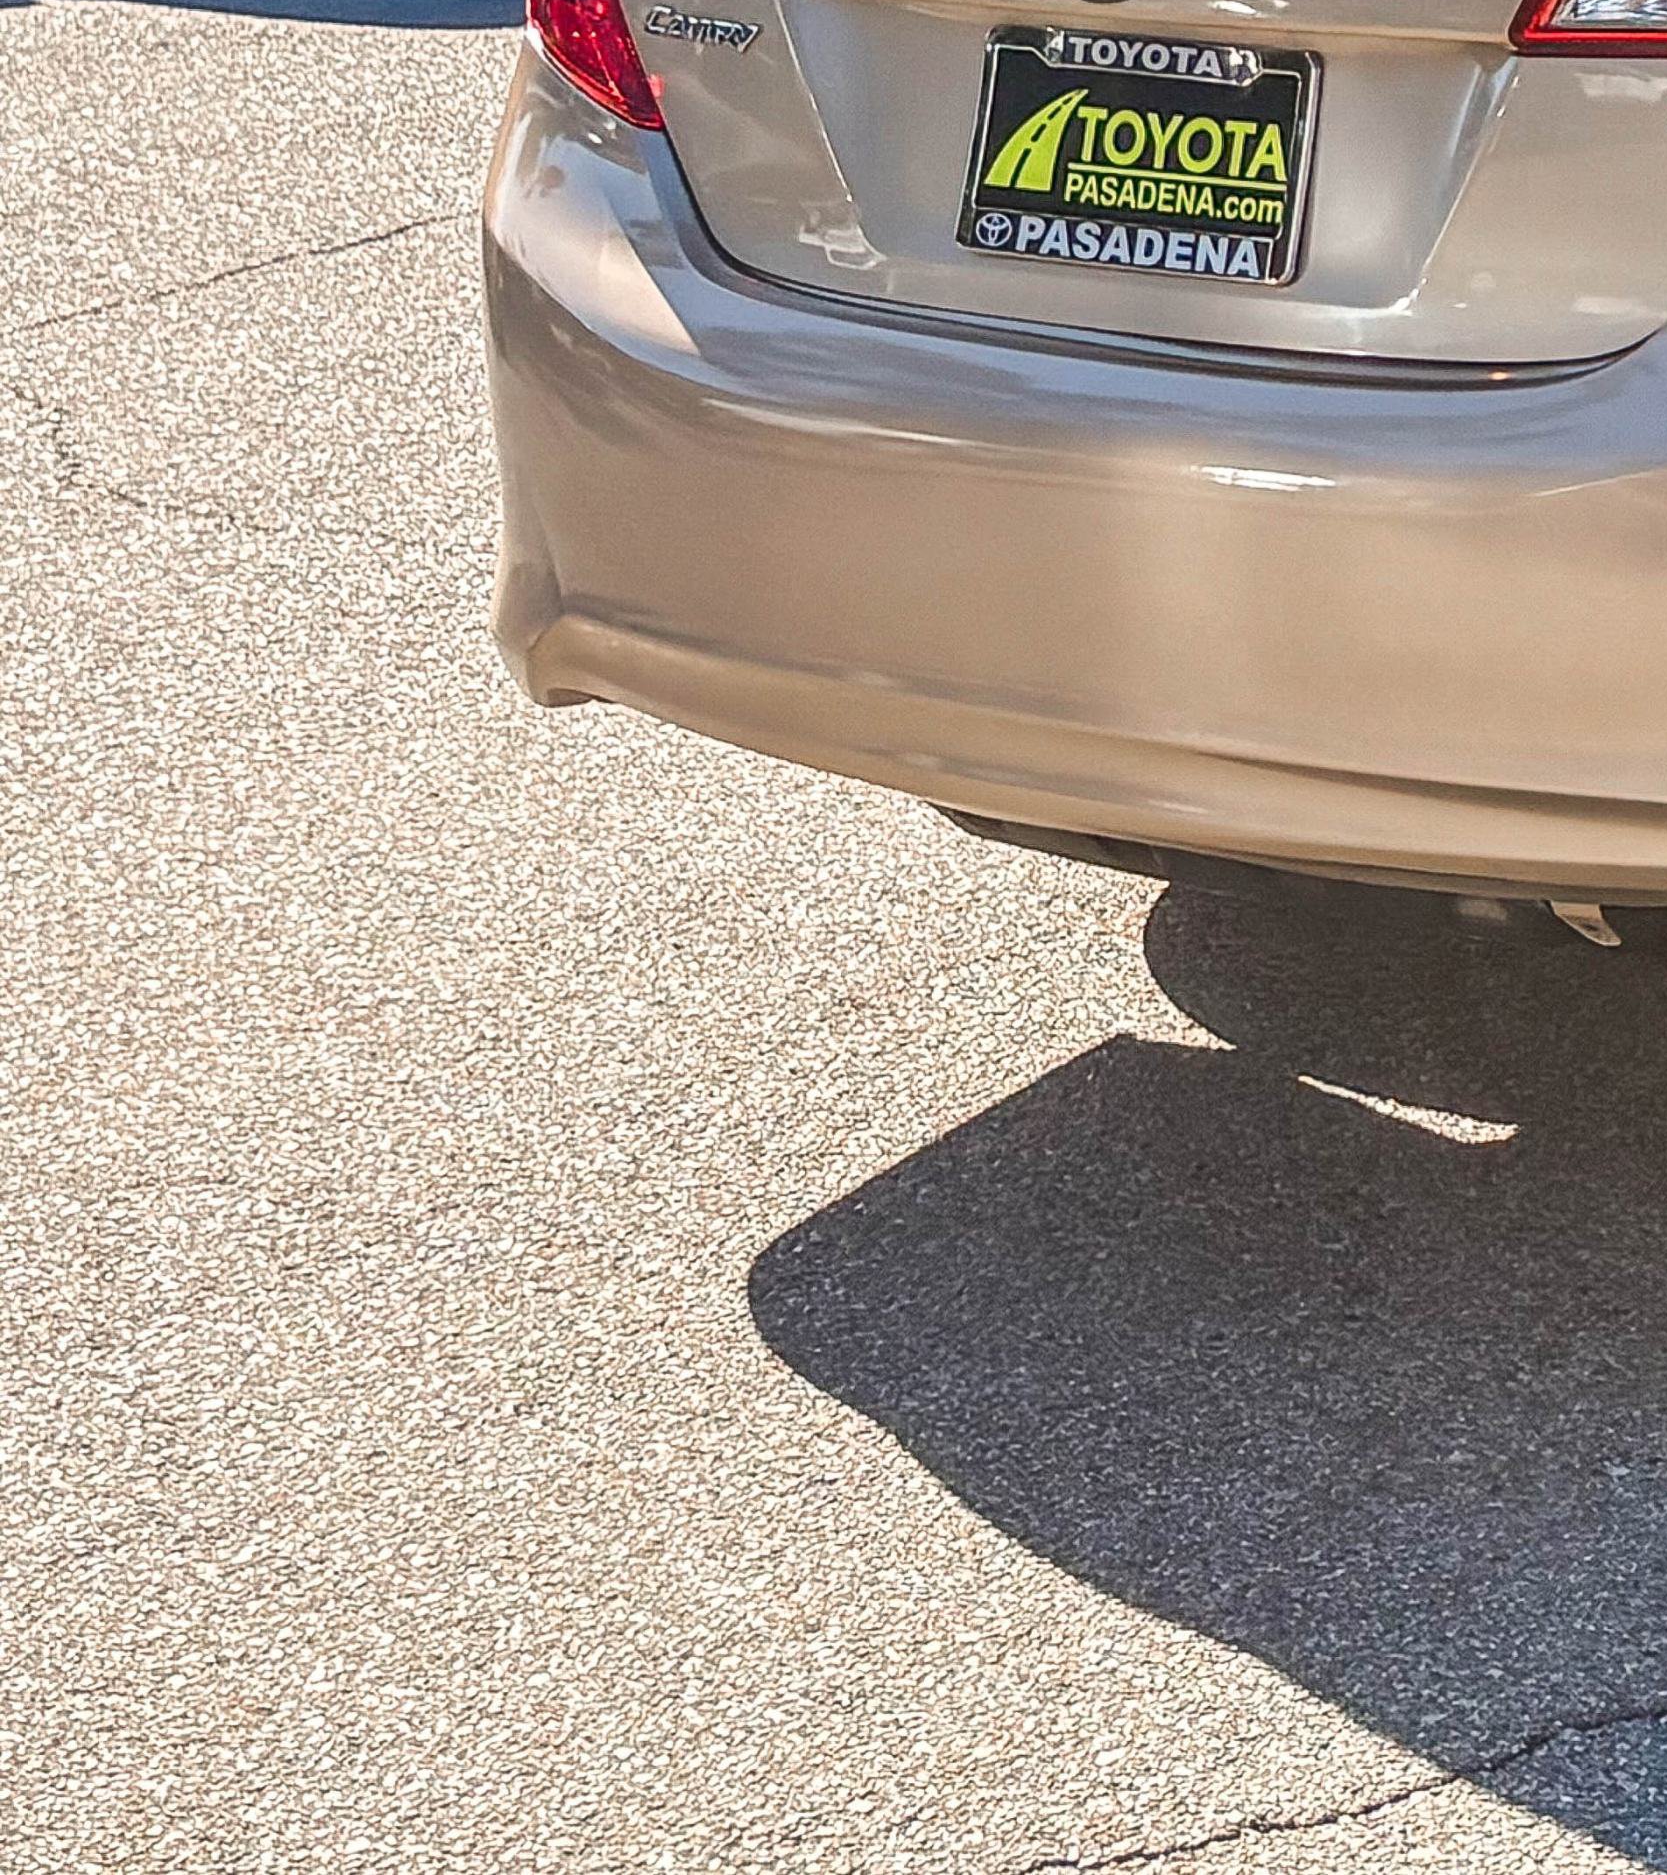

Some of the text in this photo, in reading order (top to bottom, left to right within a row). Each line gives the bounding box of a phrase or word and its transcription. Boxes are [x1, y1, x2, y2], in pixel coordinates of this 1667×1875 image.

[1069, 36, 1223, 77] TOYOTA
[1077, 106, 1288, 182] TOYOTA
[1063, 172, 1284, 224] PASADENA.com
[1015, 215, 1261, 278] PASADENA
